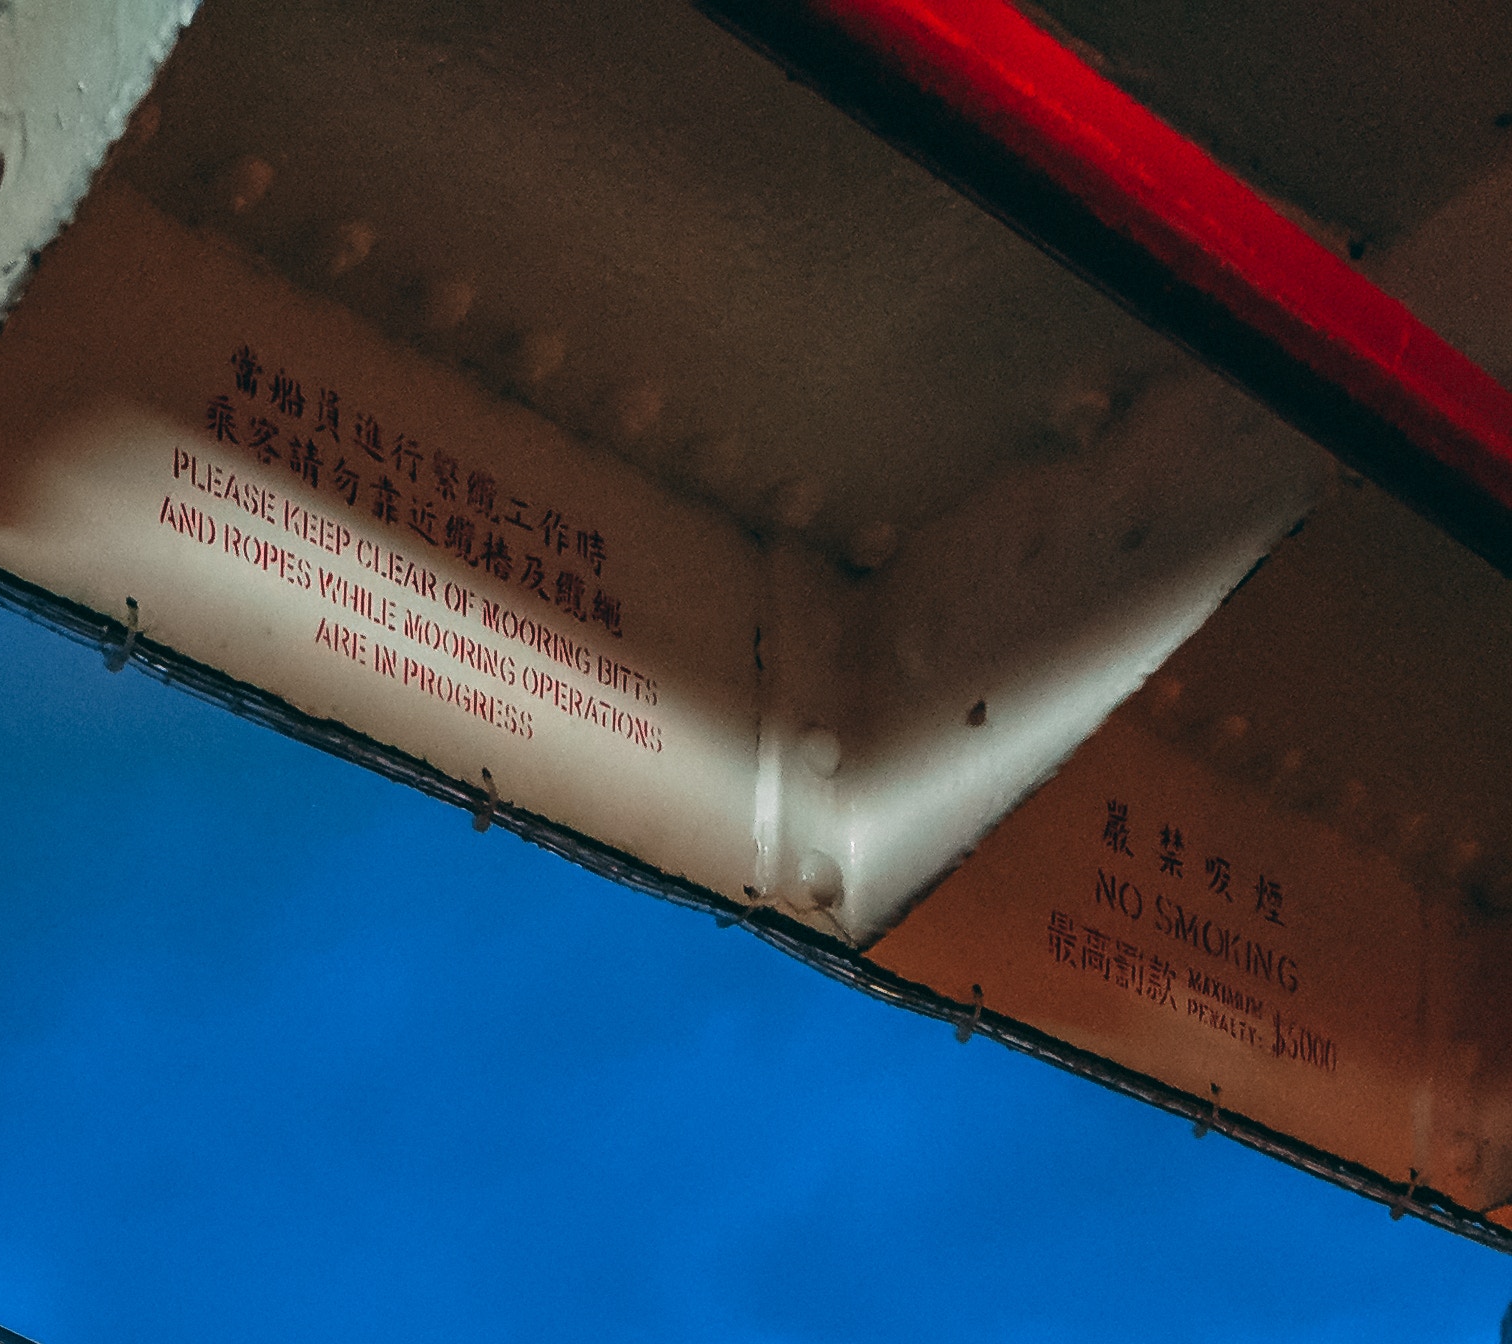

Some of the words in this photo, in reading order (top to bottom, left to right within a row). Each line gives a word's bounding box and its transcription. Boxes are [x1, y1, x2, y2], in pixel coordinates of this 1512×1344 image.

[159, 496, 216, 545] AND
[223, 527, 312, 590] ROPES
[317, 566, 396, 633] WHILE
[403, 609, 516, 687] MOORING
[522, 667, 662, 754] OPERATIONS
[173, 446, 276, 524] PLEASE
[283, 499, 351, 556] KEEP
[356, 538, 437, 602] CLEAR
[443, 581, 476, 618] OF
[482, 599, 591, 675] MOORING
[597, 654, 659, 707] BITTS
[315, 618, 367, 665] ARE
[374, 644, 397, 679] IN
[403, 657, 534, 740] PROGRESS
[1103, 800, 1285, 927] 嚴禁吸煙
[1047, 910, 1178, 1011] 最高罰款
[1095, 868, 1143, 920] NO
[1155, 895, 1300, 994] SMOKING
[1188, 967, 1263, 1020] MAXIMUM
[1272, 1010, 1337, 1072] $5000
